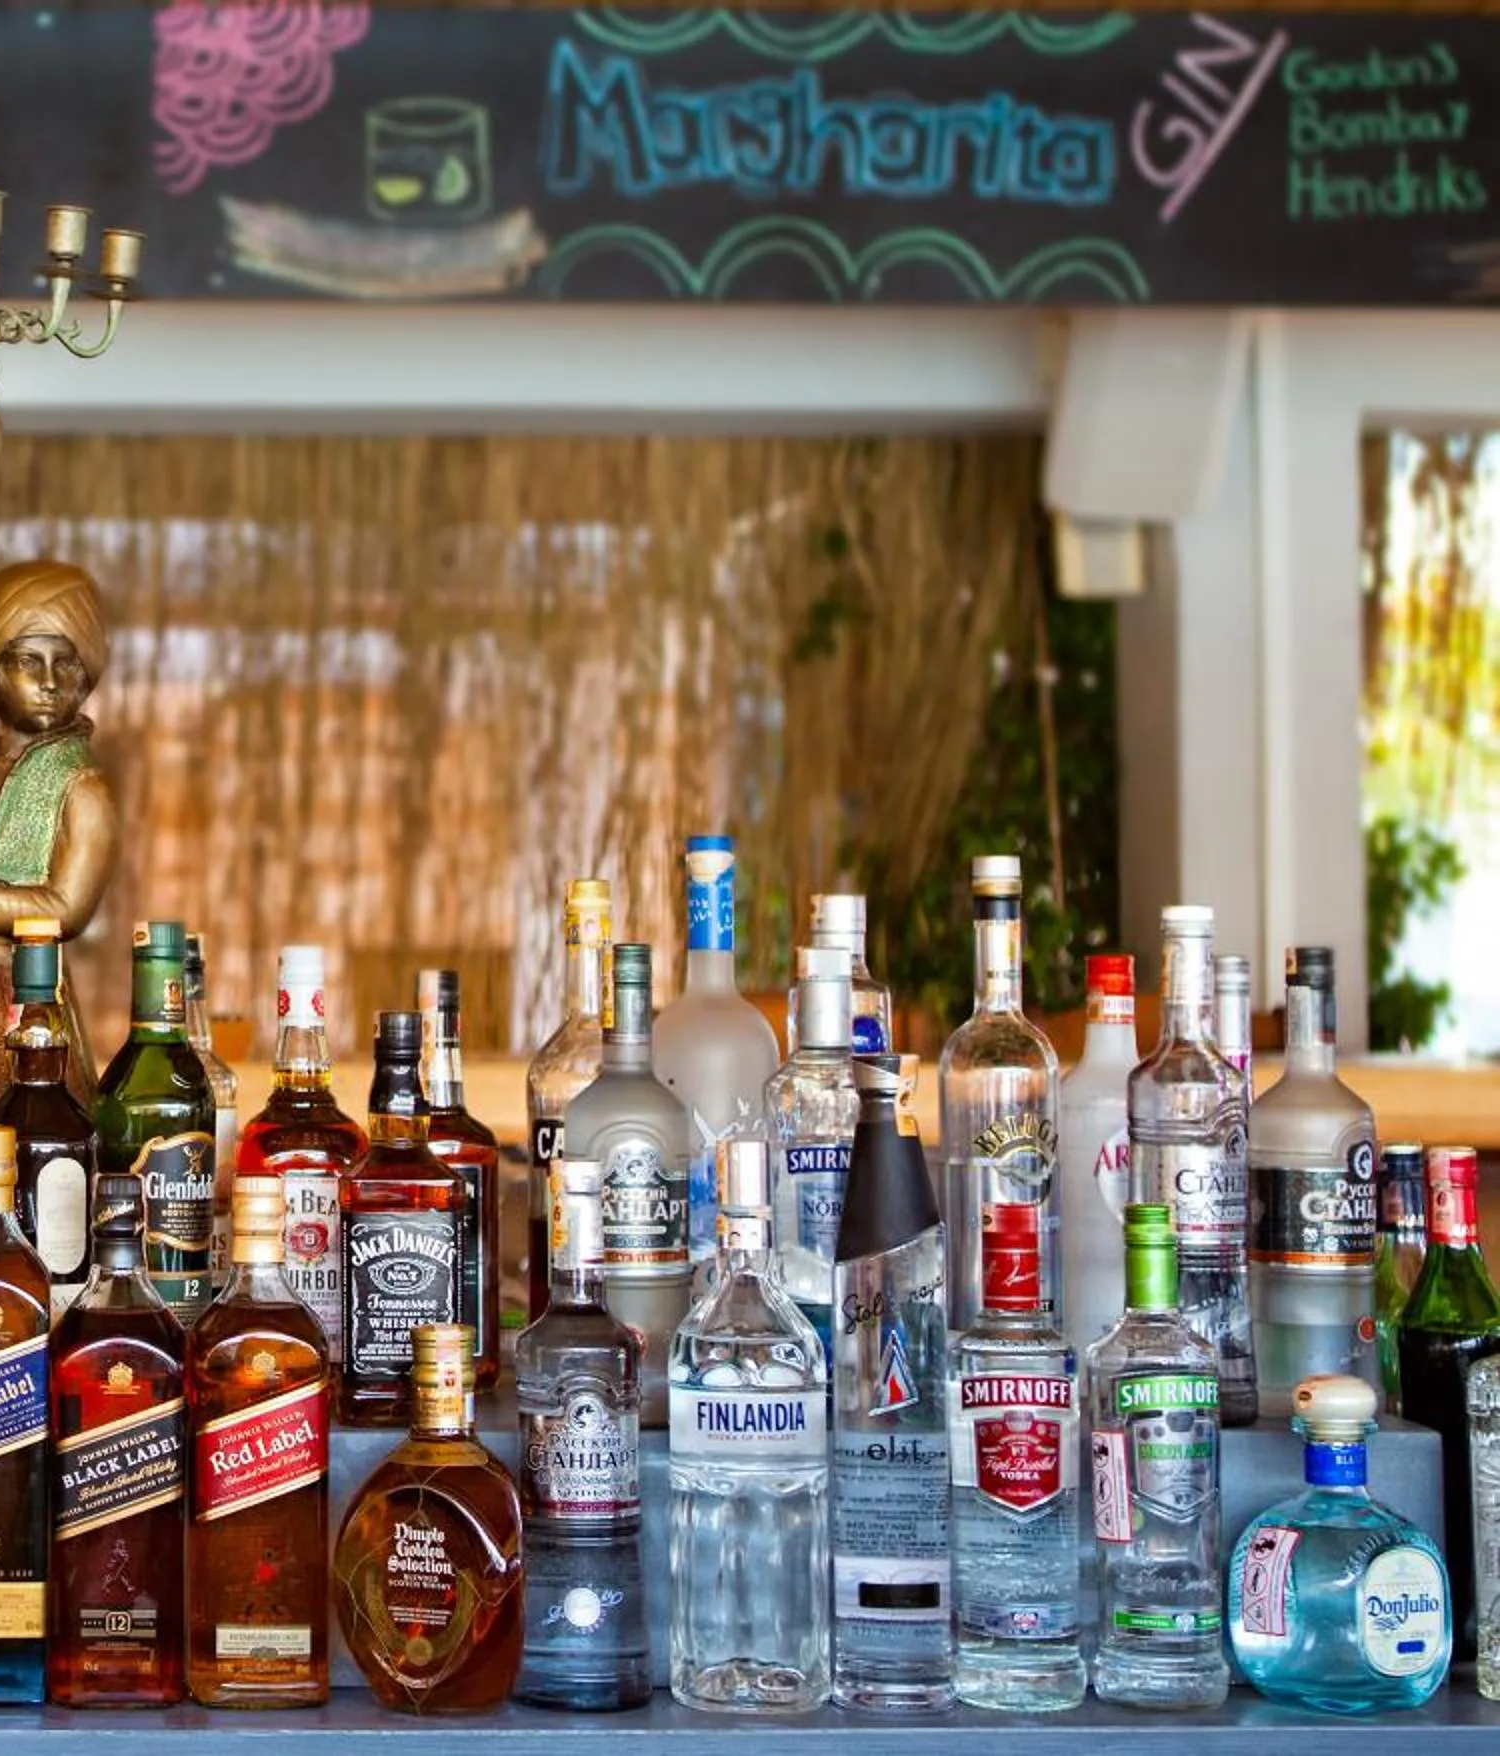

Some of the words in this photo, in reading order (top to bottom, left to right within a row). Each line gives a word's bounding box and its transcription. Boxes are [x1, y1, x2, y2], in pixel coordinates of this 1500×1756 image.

[1129, 11, 1258, 188] GIN
[544, 37, 1114, 204] Margharita
[1287, 94, 1470, 153] Bombay
[789, 1149, 850, 1172] SMIRN
[350, 1233, 392, 1266] JACK
[184, 1279, 200, 1297] 12
[963, 1379, 1069, 1405] SMIRNOFF
[1120, 1381, 1219, 1407] SMIRNOFF
[696, 1401, 806, 1432] FINLANDIA
[61, 1456, 123, 1489] BLACK
[124, 1435, 182, 1467] LABEL
[208, 1441, 257, 1475] Red
[256, 1419, 317, 1459] Label
[109, 1616, 128, 1632] 12
